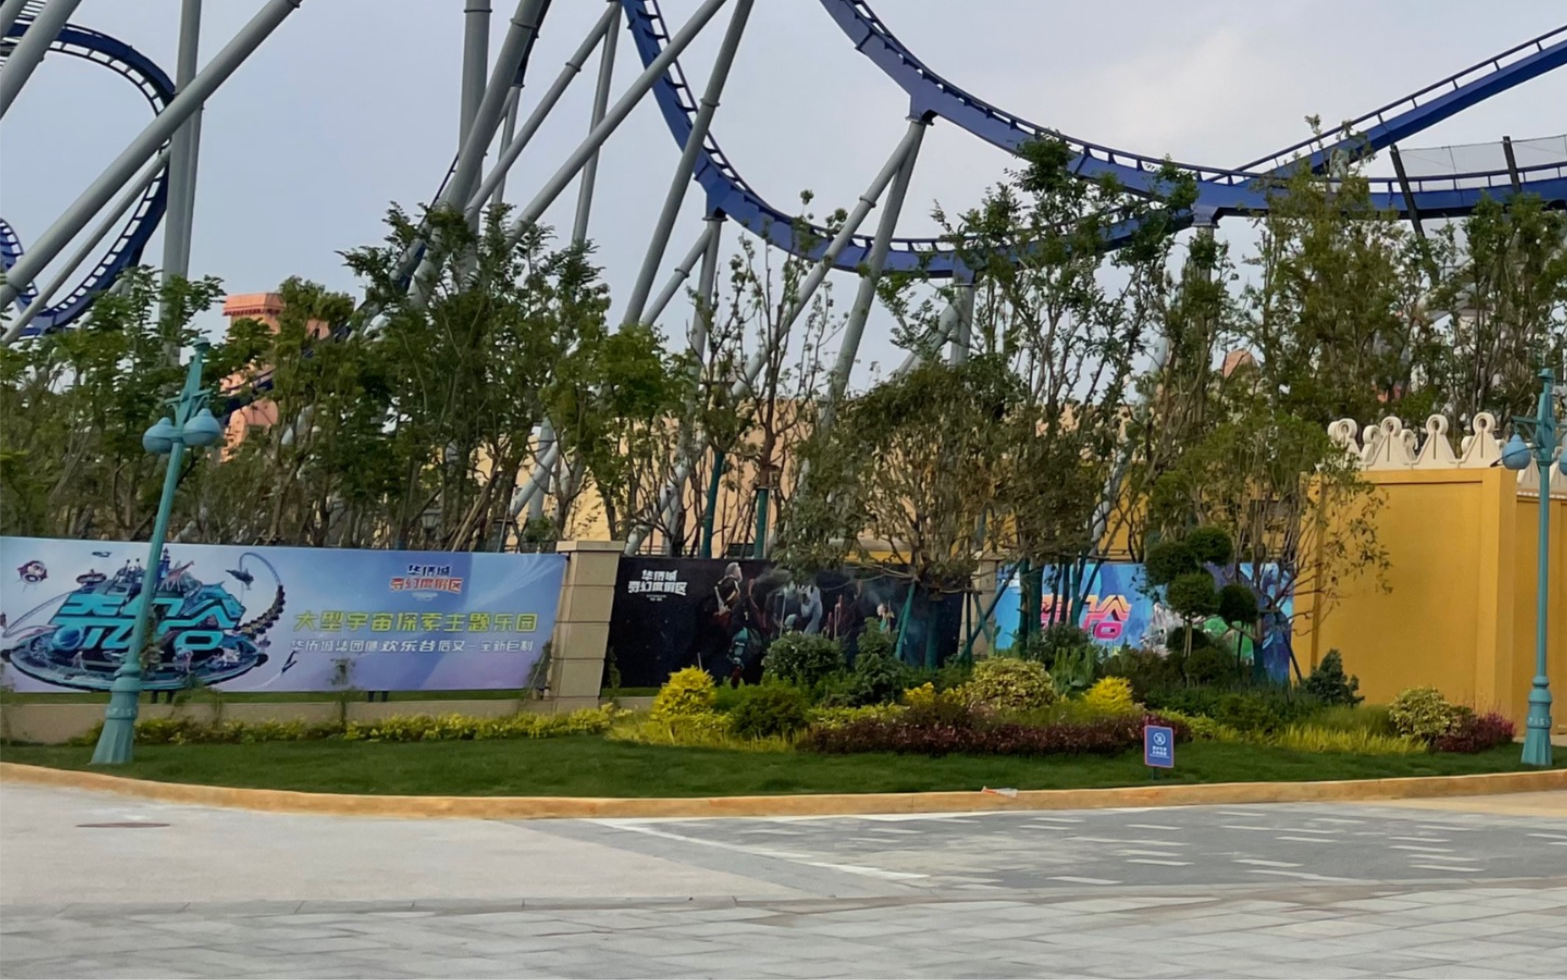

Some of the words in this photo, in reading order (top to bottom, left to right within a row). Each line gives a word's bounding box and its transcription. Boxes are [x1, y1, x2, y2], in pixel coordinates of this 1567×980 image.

[293, 610, 539, 633] 大型宇宙探索主题乐园
